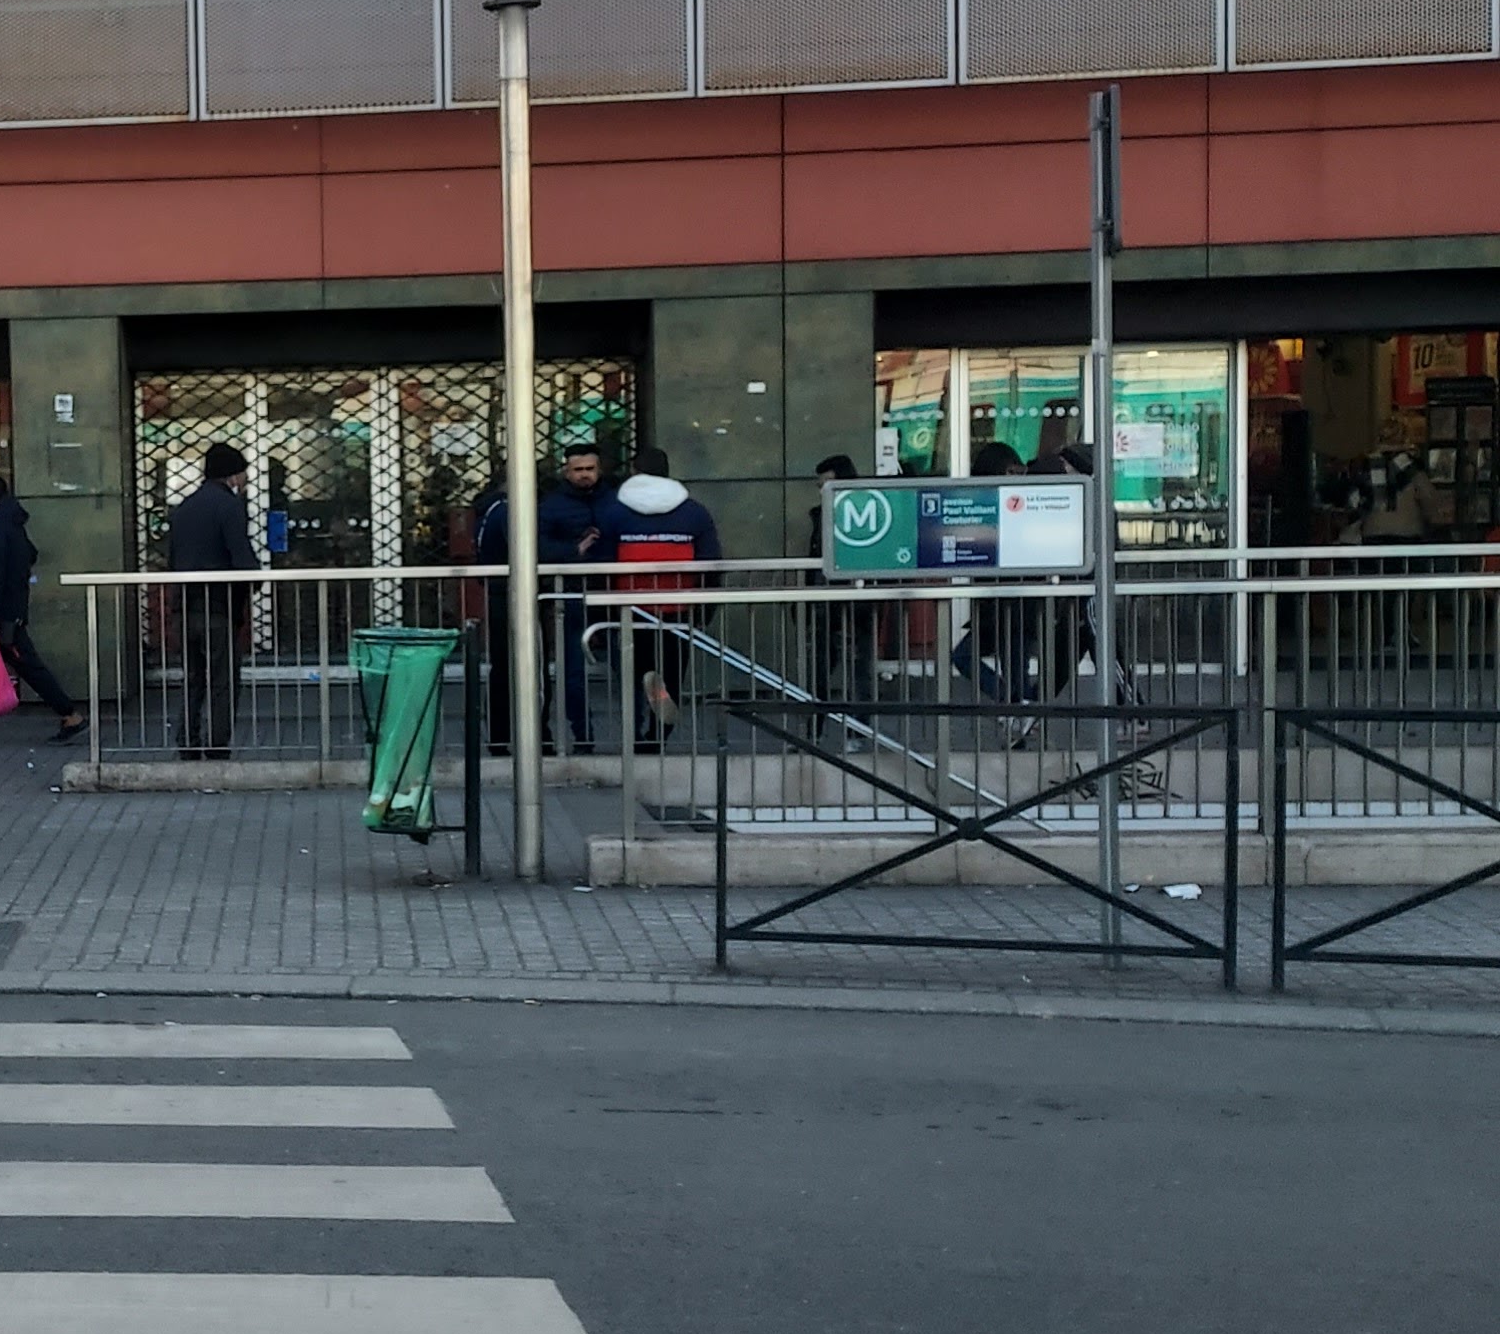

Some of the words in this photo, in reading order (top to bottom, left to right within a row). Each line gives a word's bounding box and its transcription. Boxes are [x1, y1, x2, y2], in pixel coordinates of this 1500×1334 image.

[1413, 344, 1435, 369] 10
[1011, 496, 1020, 509] 7
[843, 498, 877, 533] M
